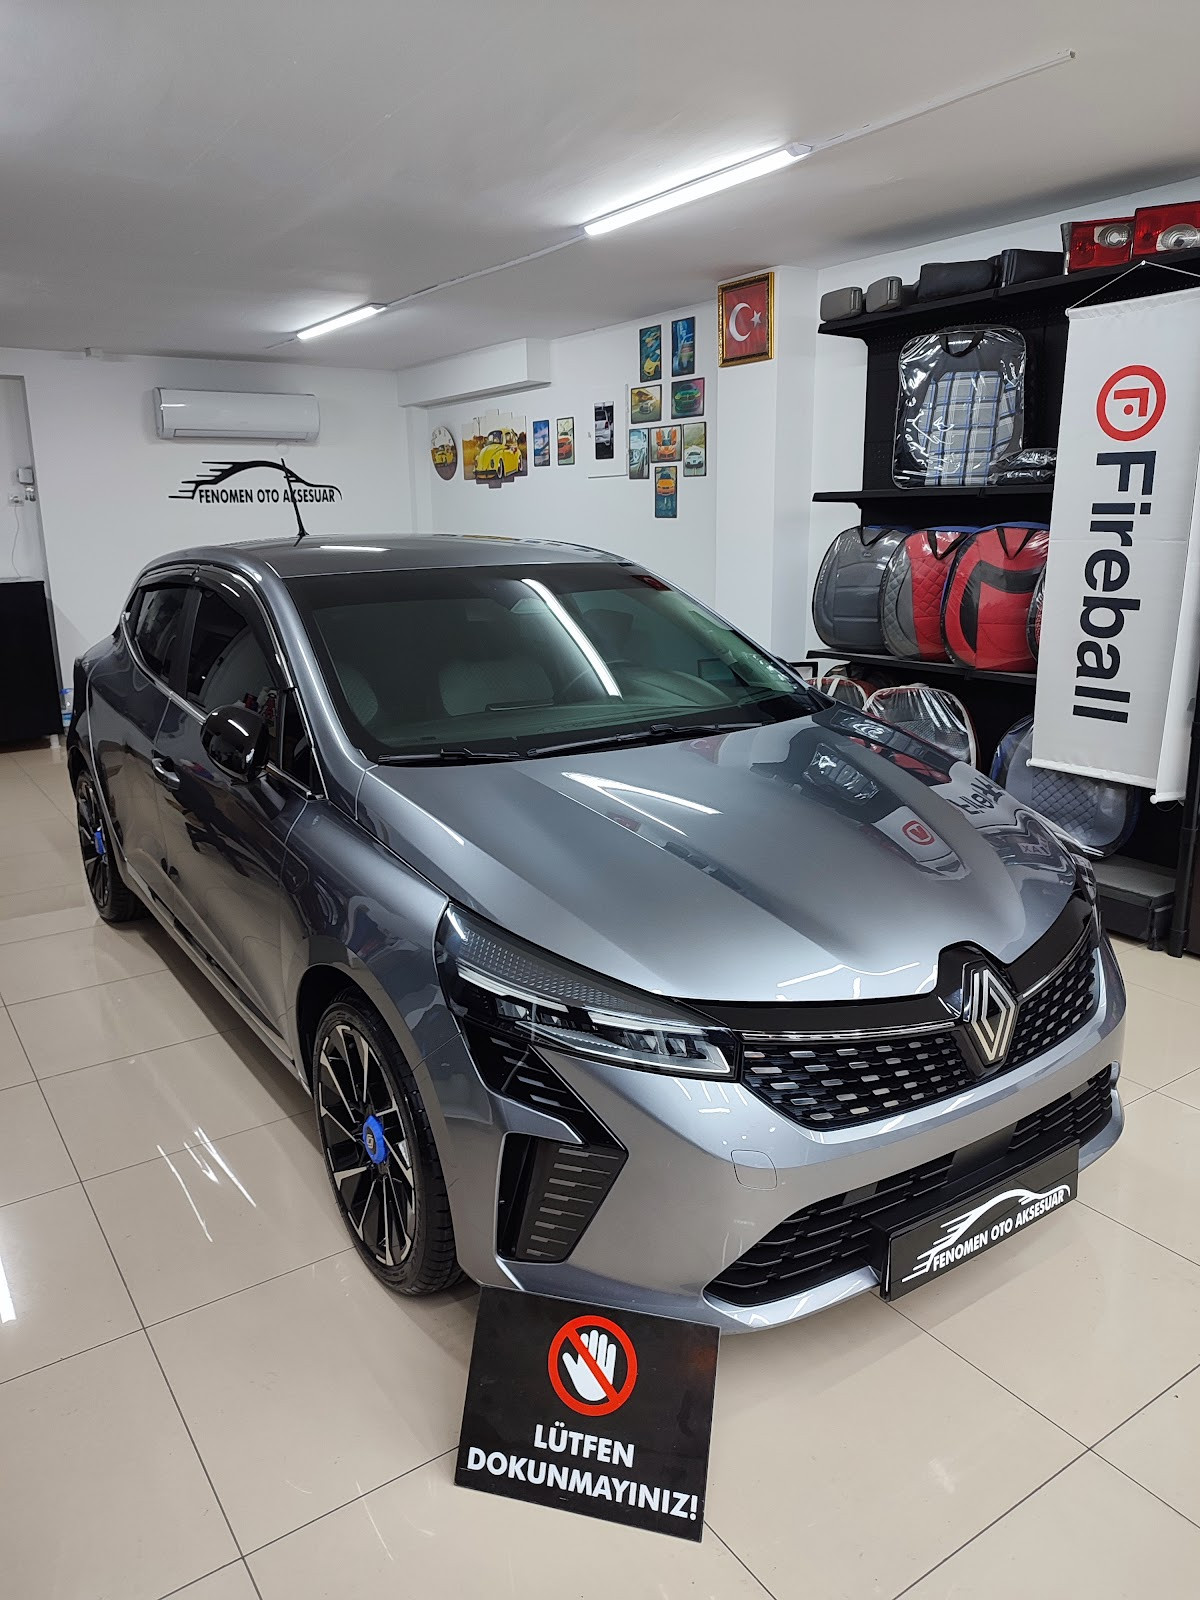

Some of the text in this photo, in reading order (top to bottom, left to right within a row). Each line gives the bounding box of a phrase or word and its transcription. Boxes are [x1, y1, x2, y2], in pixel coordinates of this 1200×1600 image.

[198, 489, 254, 504] FENOMEN
[257, 489, 280, 503] OTO
[1072, 450, 1157, 723] Fireball
[932, 1189, 1064, 1271] FENOMEN OTO AKSESUAR
[533, 1421, 635, 1468] LÜTFEN
[467, 1446, 699, 1521] DOKUNMAYINIZ!
